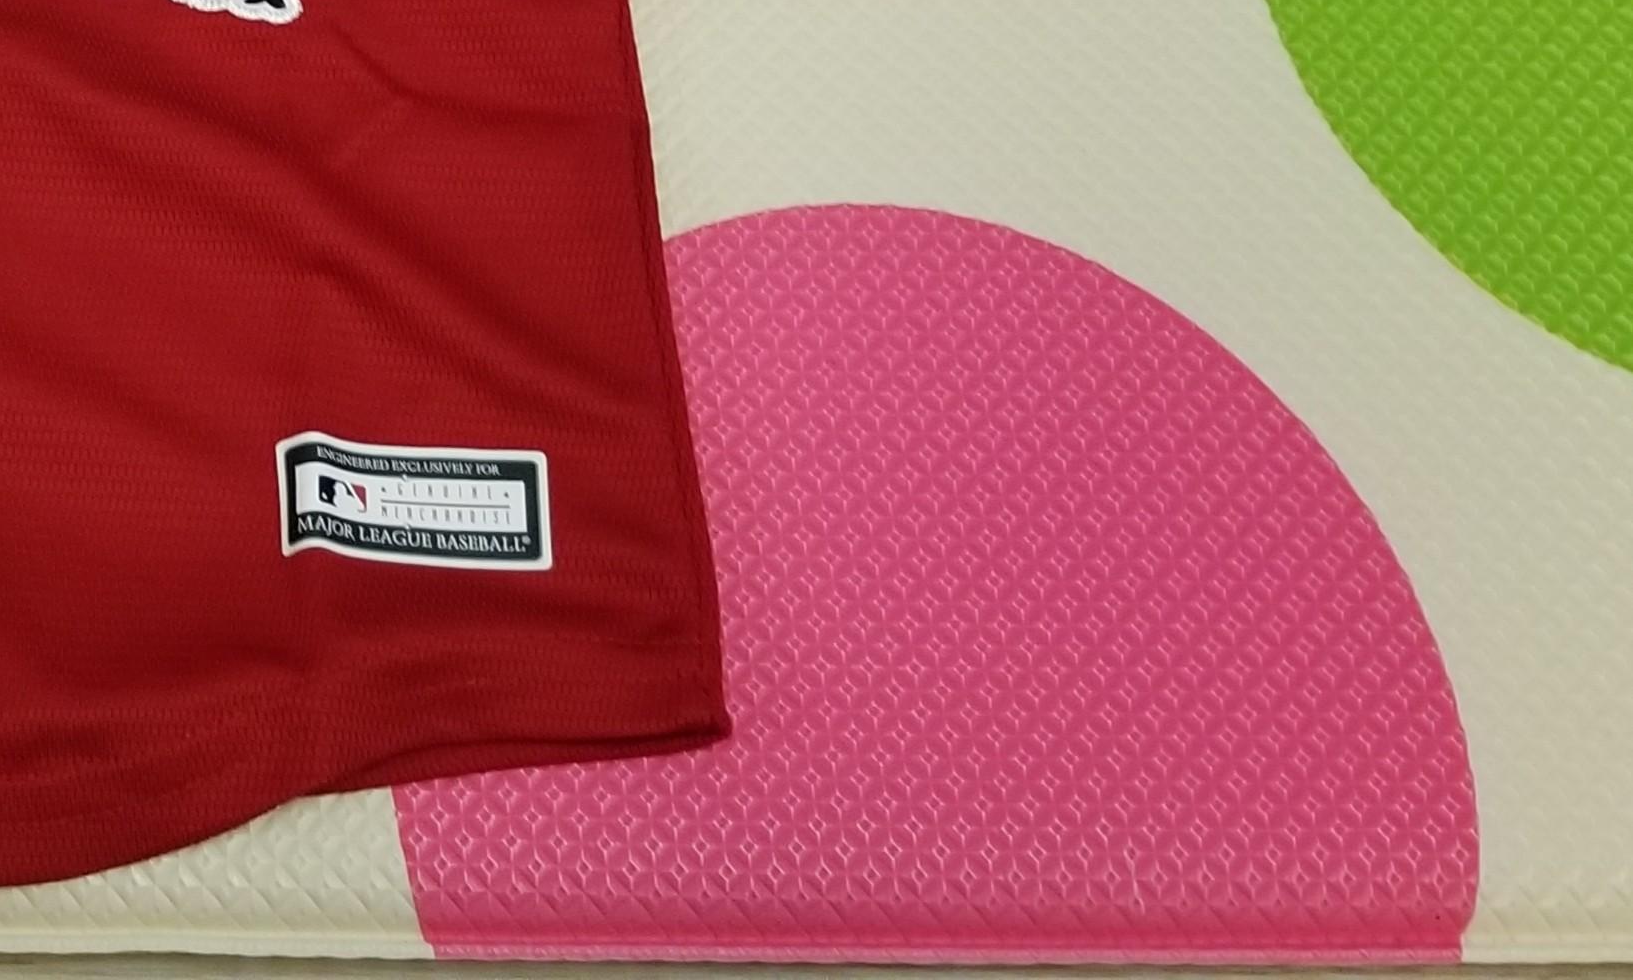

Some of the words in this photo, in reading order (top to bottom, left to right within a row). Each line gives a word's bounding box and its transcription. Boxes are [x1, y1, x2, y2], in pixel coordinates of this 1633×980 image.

[316, 445, 390, 472] ENGINEERED
[391, 459, 474, 476] EXCLUSIVELY
[475, 462, 501, 477] FOR
[297, 515, 356, 541] MAJOR
[358, 525, 433, 549] LEAGUE
